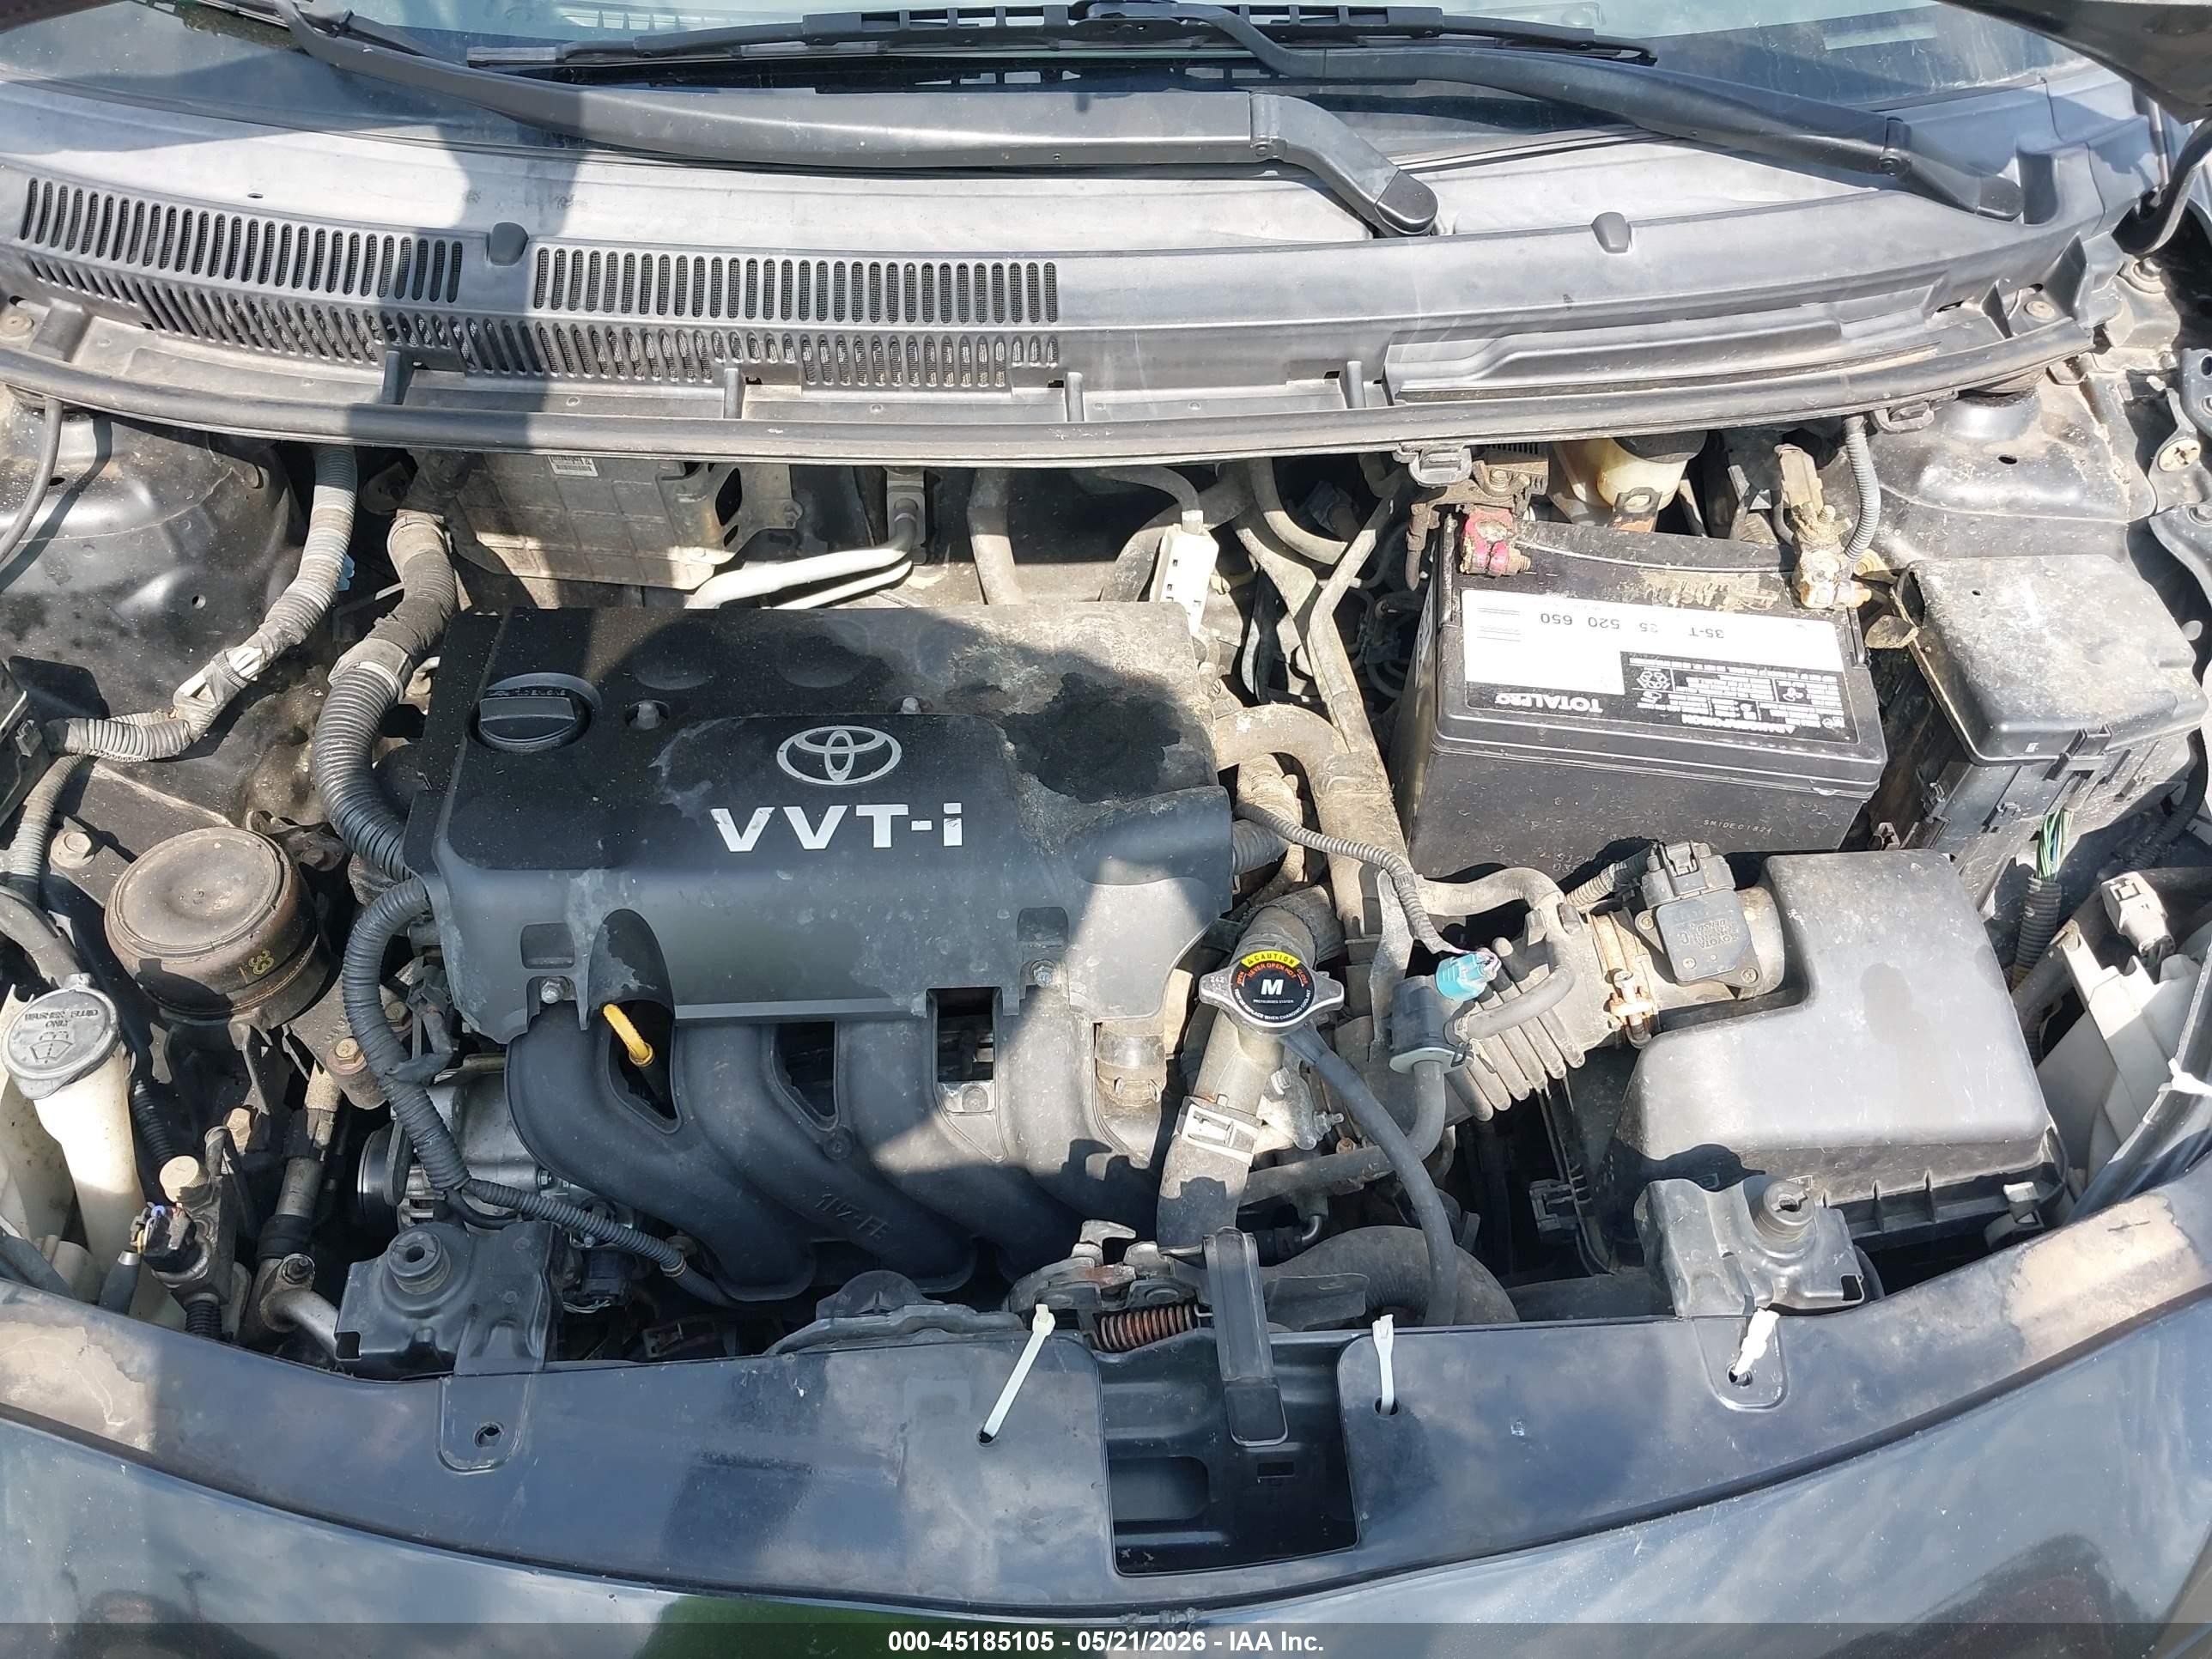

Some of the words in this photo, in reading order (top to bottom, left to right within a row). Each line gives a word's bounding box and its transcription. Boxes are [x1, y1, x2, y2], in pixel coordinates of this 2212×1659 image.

[1540, 612, 1573, 626] 650
[1588, 617, 1620, 629] 520
[1688, 626, 1724, 639] 35-T
[710, 803, 963, 852] VVT-i
[1255, 953, 1295, 965] CAUTION
[1261, 979, 1284, 995] M
